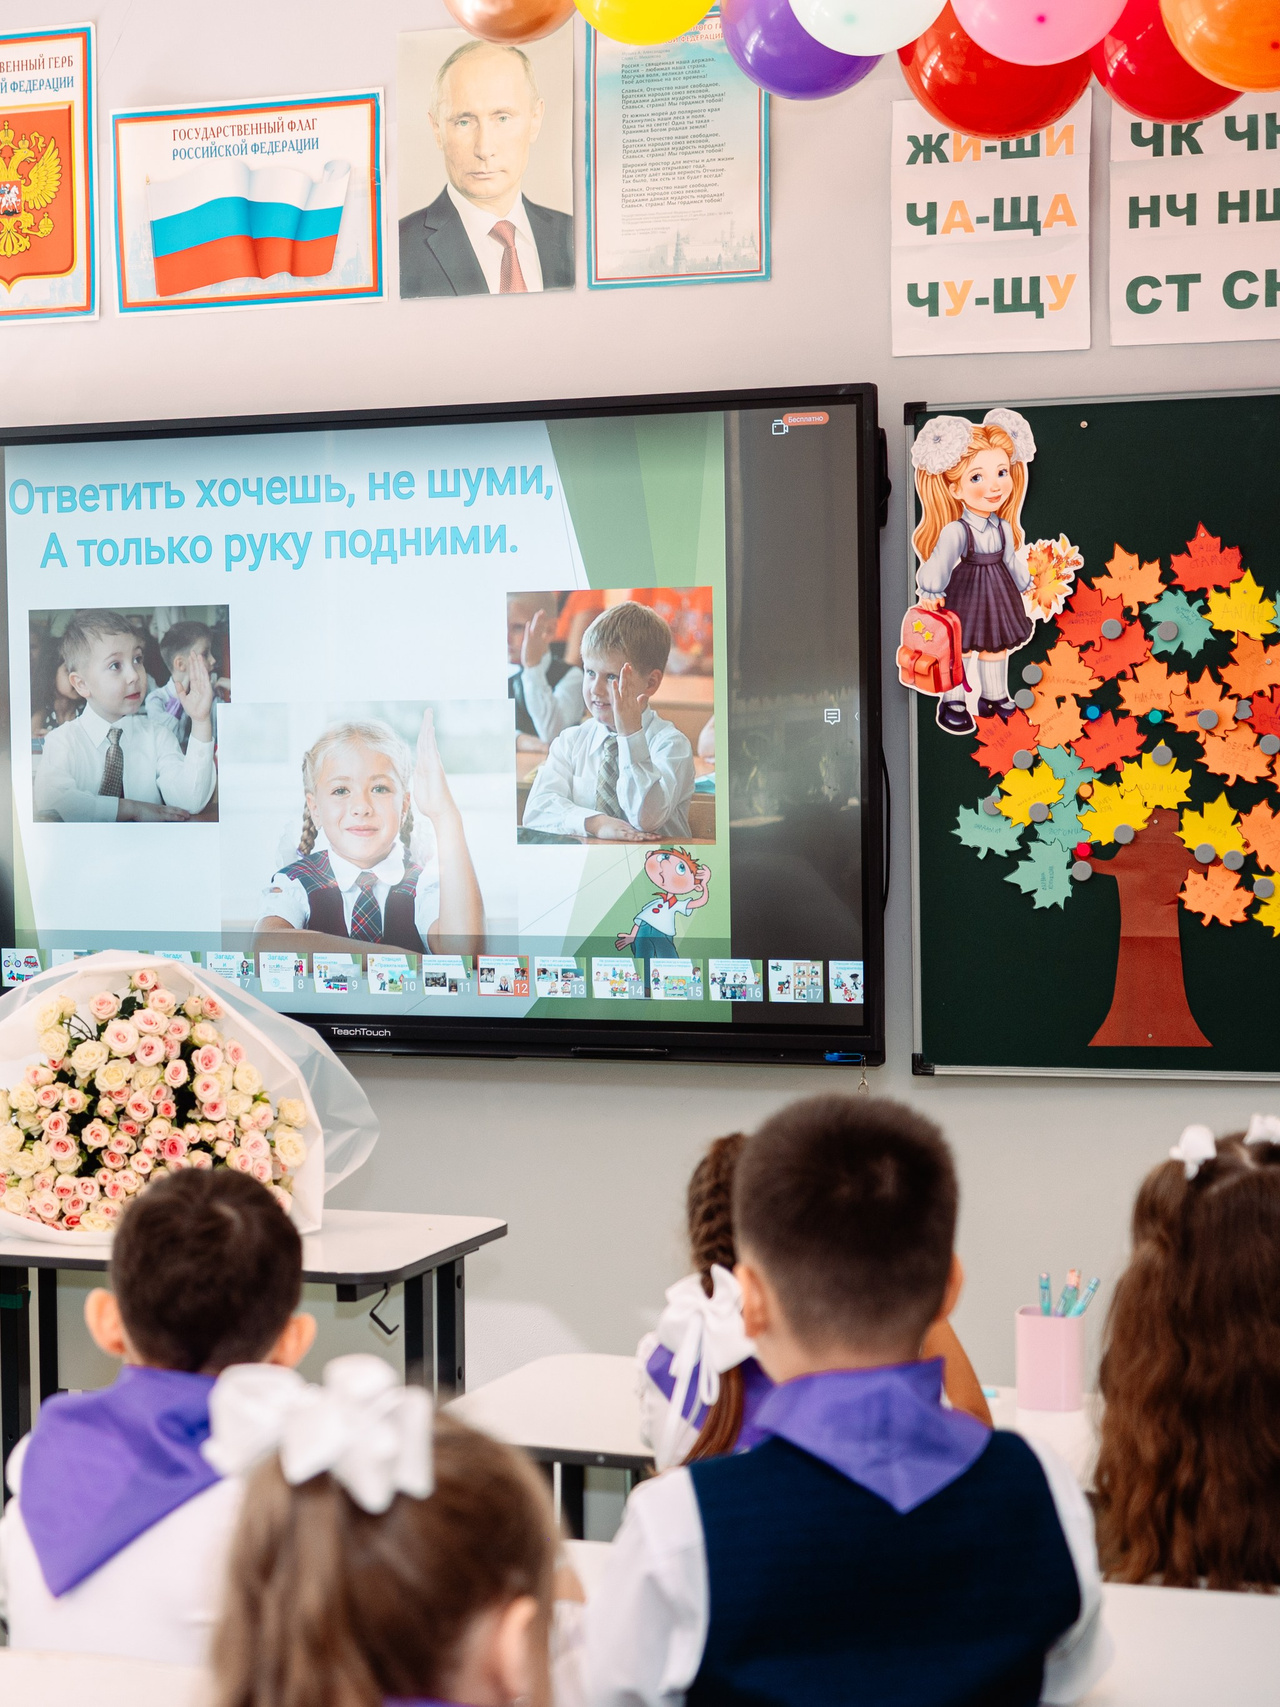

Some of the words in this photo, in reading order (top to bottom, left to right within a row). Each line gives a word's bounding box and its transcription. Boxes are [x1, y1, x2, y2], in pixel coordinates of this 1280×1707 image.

[48, 55, 74, 68] ГЕРБ
[10, 76, 74, 93] ФЕДЕРАЦИИ
[172, 117, 284, 141] ГОСУДАРСТВЕННЫЙ
[287, 118, 317, 132] ФЛАГ
[906, 124, 1075, 165] ЖИ-ШИ
[1130, 120, 1204, 157] ЧК
[172, 139, 248, 160] РОССИЙСКОЙ
[250, 138, 319, 155] ФЕДЕРАЦИИ
[906, 193, 1078, 236] ЧА-ЩА
[1129, 193, 1197, 229] НЧ
[907, 274, 1077, 319] ЧУ-ЩУ
[1125, 273, 1201, 314] СТ
[8, 478, 186, 515] Ответить
[195, 474, 355, 509] хочешь,
[368, 470, 415, 501] не
[428, 465, 553, 507] шуми,
[39, 532, 68, 568] А
[76, 535, 212, 567] только
[224, 531, 313, 572] руку
[324, 524, 518, 565] подними.
[244, 978, 250, 988] 7
[297, 980, 304, 989] 8
[351, 980, 358, 990] 9
[404, 981, 416, 991] 10
[459, 982, 471, 992] 11
[515, 984, 528, 994] 12
[572, 984, 585, 995] 13
[630, 985, 643, 996] 14
[689, 986, 702, 996] 15
[748, 988, 761, 998] 16
[808, 988, 822, 999] 17
[331, 1026, 391, 1037] TeachTouch
